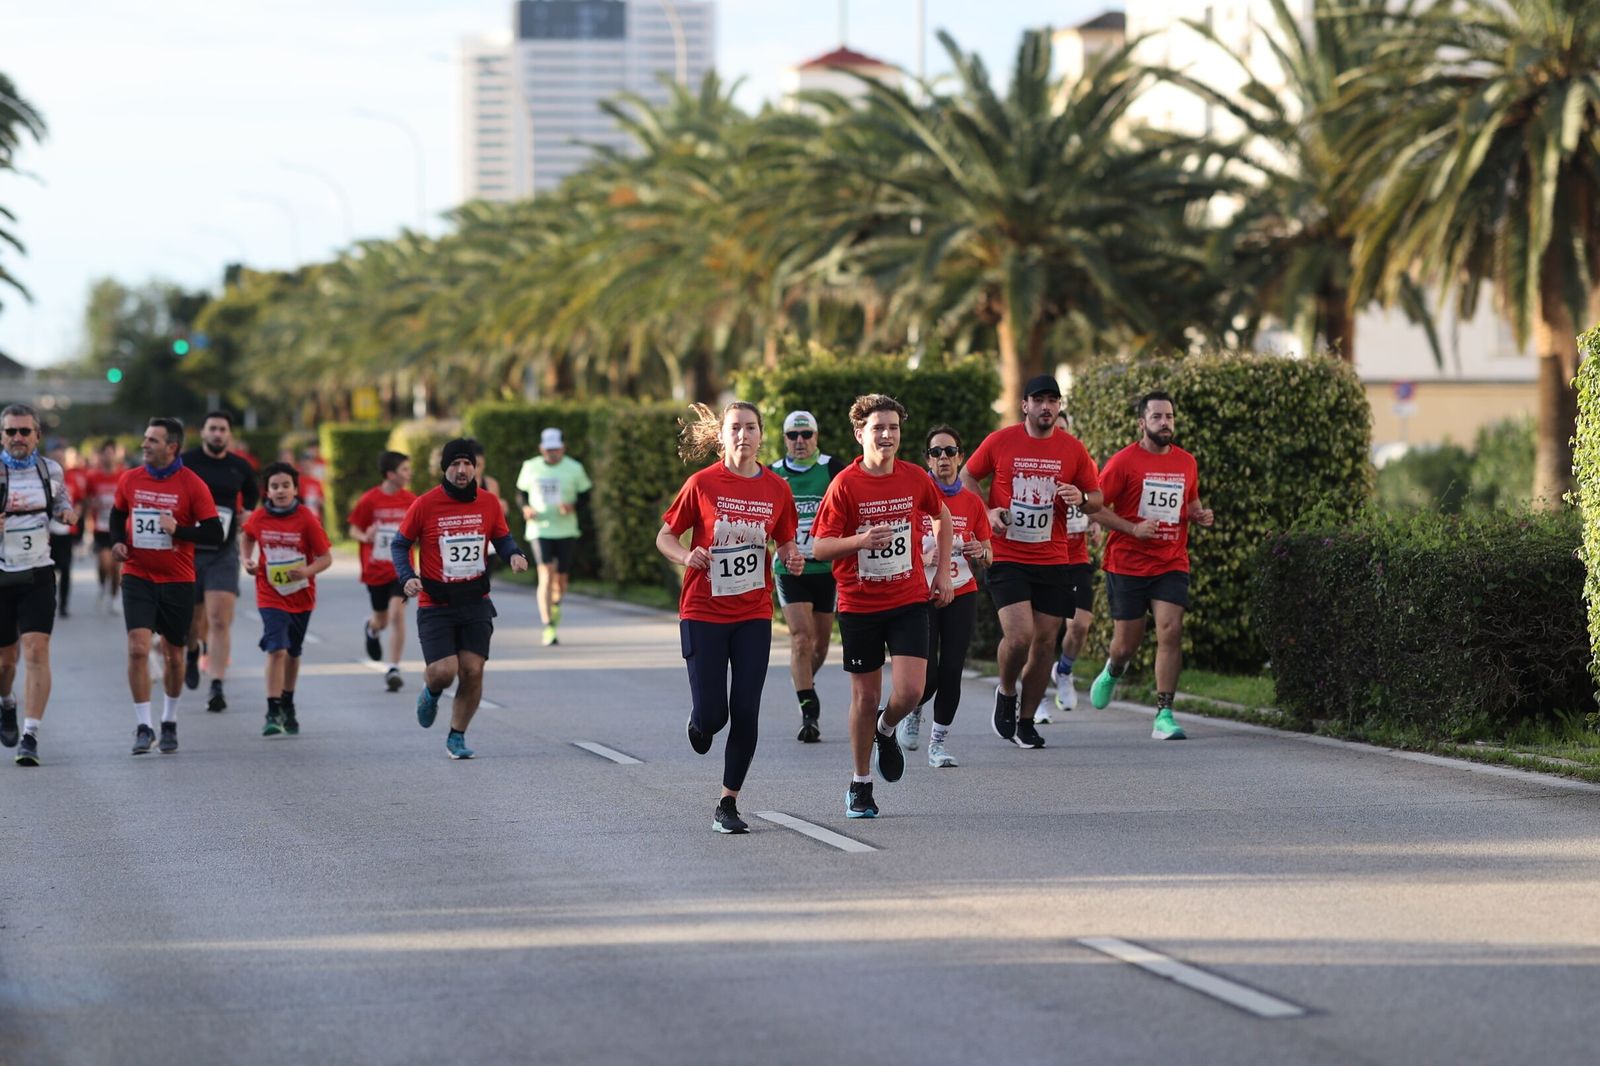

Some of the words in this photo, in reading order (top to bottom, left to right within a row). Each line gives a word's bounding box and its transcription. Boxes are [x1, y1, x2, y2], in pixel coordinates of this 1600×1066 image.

[1039, 463, 1061, 471] JARDÍN
[725, 497, 747, 505] CARRERA
[859, 506, 886, 514] CIUDAD
[888, 501, 913, 512] JARDÍN
[1148, 491, 1178, 508] 156
[717, 501, 745, 511] CIUDAD
[746, 504, 773, 515] JARDÍN
[1014, 511, 1048, 529] 310
[22, 535, 32, 551] 3
[450, 546, 480, 562] 323
[719, 553, 758, 578] 189
